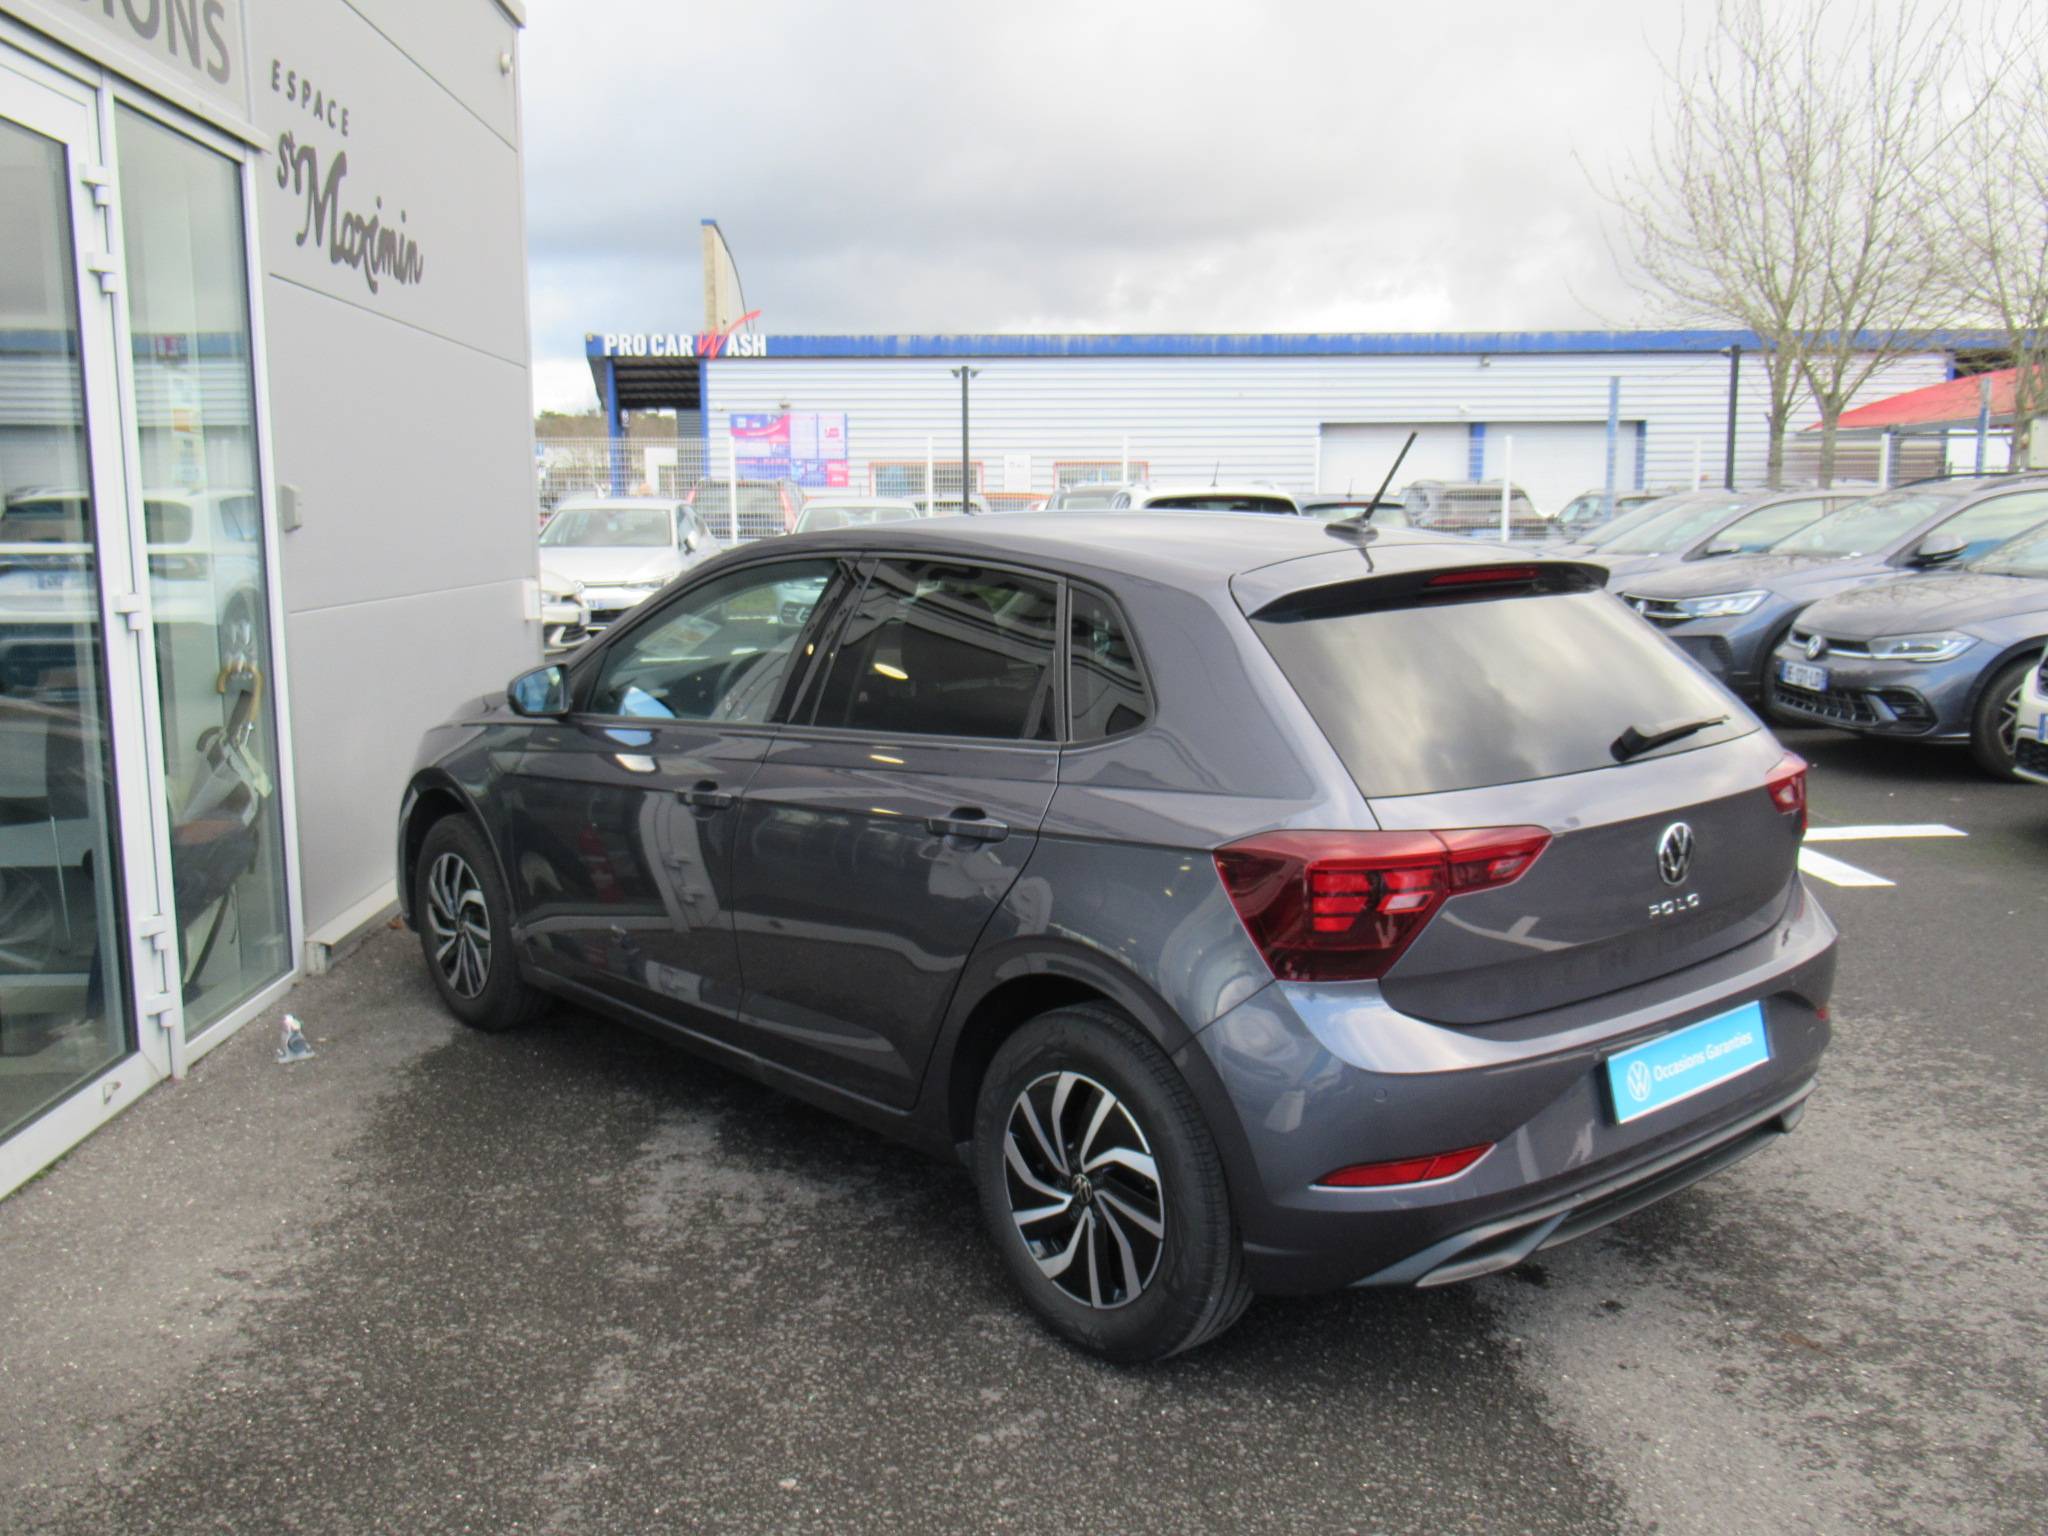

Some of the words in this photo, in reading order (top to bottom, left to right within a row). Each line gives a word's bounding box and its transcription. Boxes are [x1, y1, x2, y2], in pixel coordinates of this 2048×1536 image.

[271, 58, 349, 137] ESPACE
[295, 145, 424, 294] Maximin
[603, 333, 648, 357] PRO
[650, 333, 694, 357] CAR
[696, 309, 767, 361] WASH
[1648, 893, 1699, 919] POLO
[1653, 1051, 1706, 1082] Occasions
[1705, 1032, 1753, 1060] Garanties
